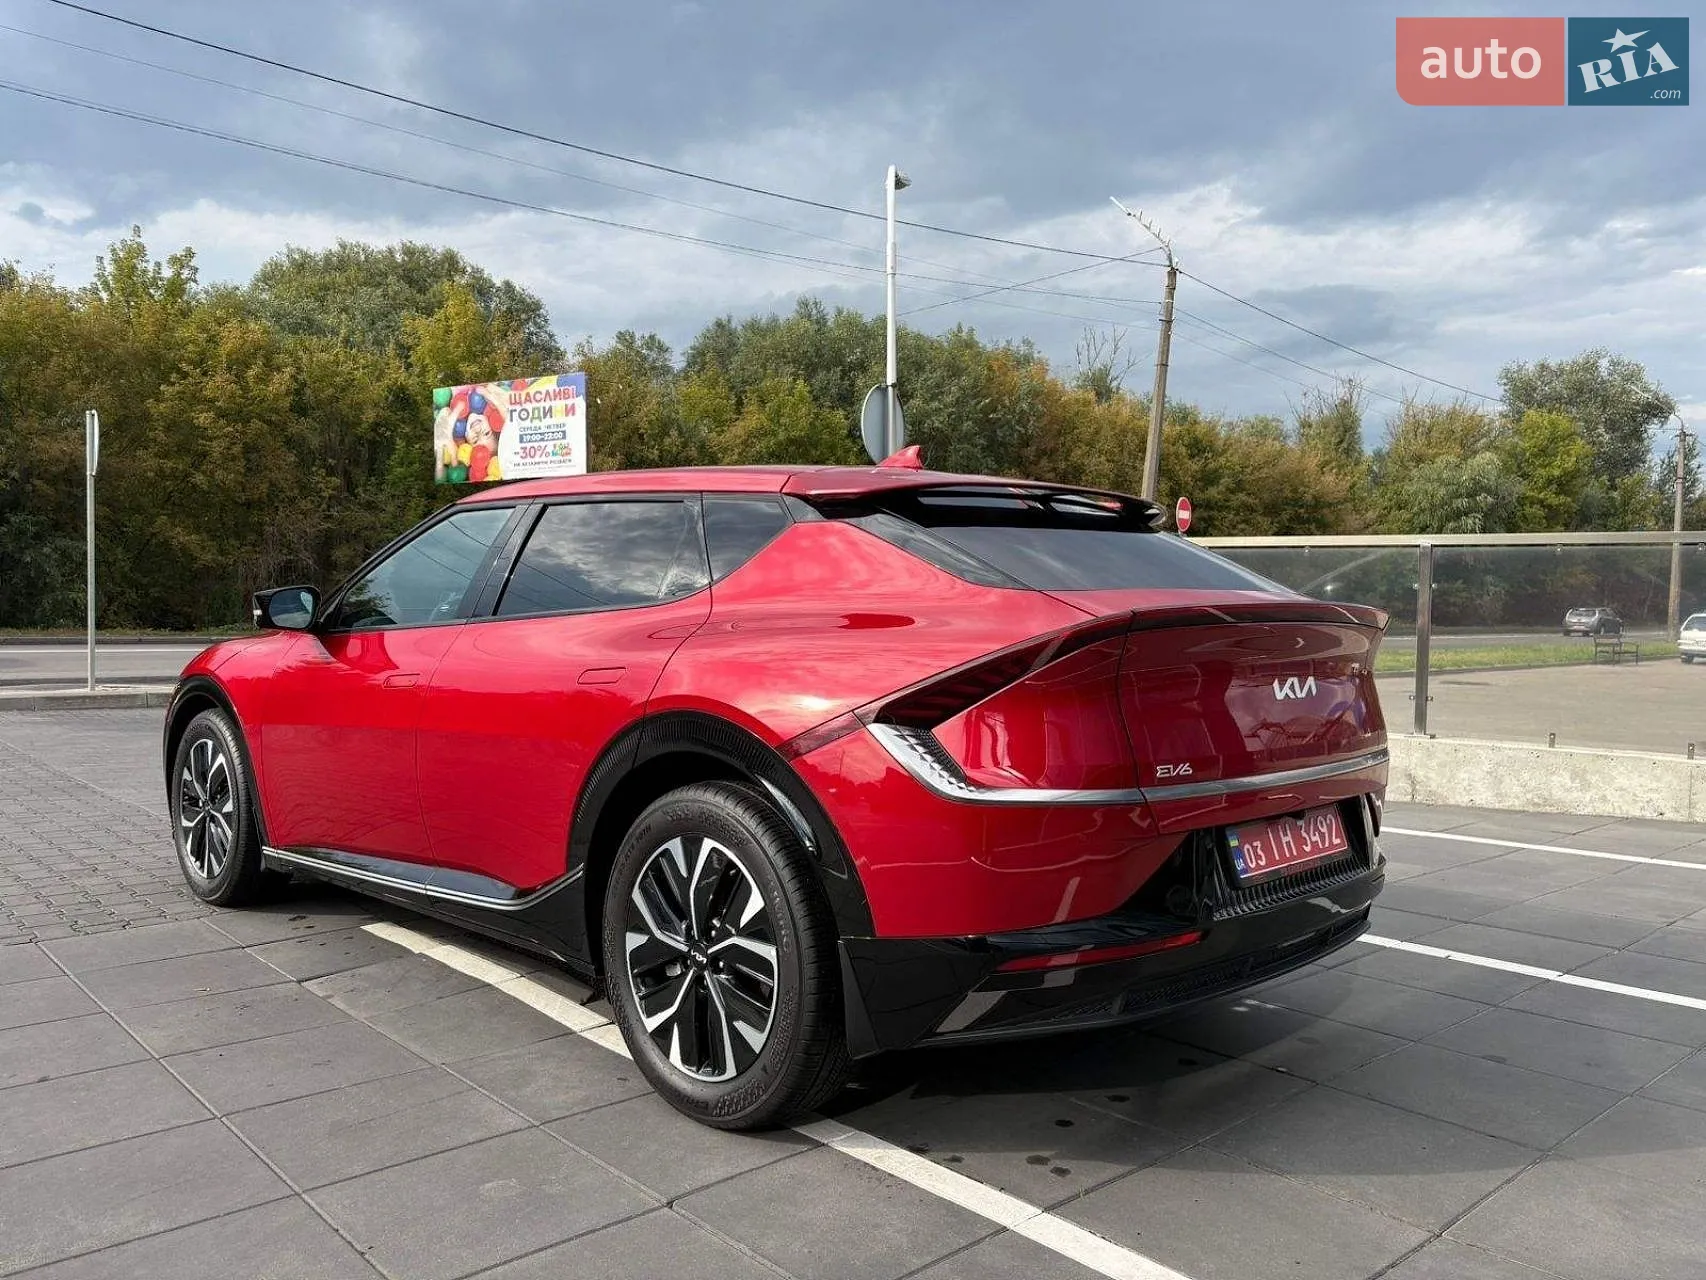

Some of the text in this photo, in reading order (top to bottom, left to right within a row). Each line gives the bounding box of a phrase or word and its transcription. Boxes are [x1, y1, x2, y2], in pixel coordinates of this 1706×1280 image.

[509, 387, 576, 406] ЩАСЛИВІ
[509, 403, 576, 422] ГОДИНИ
[1272, 676, 1317, 700] KIA
[1156, 762, 1193, 778] EV6
[1243, 840, 1266, 869] 03
[1297, 814, 1341, 852] 3492
